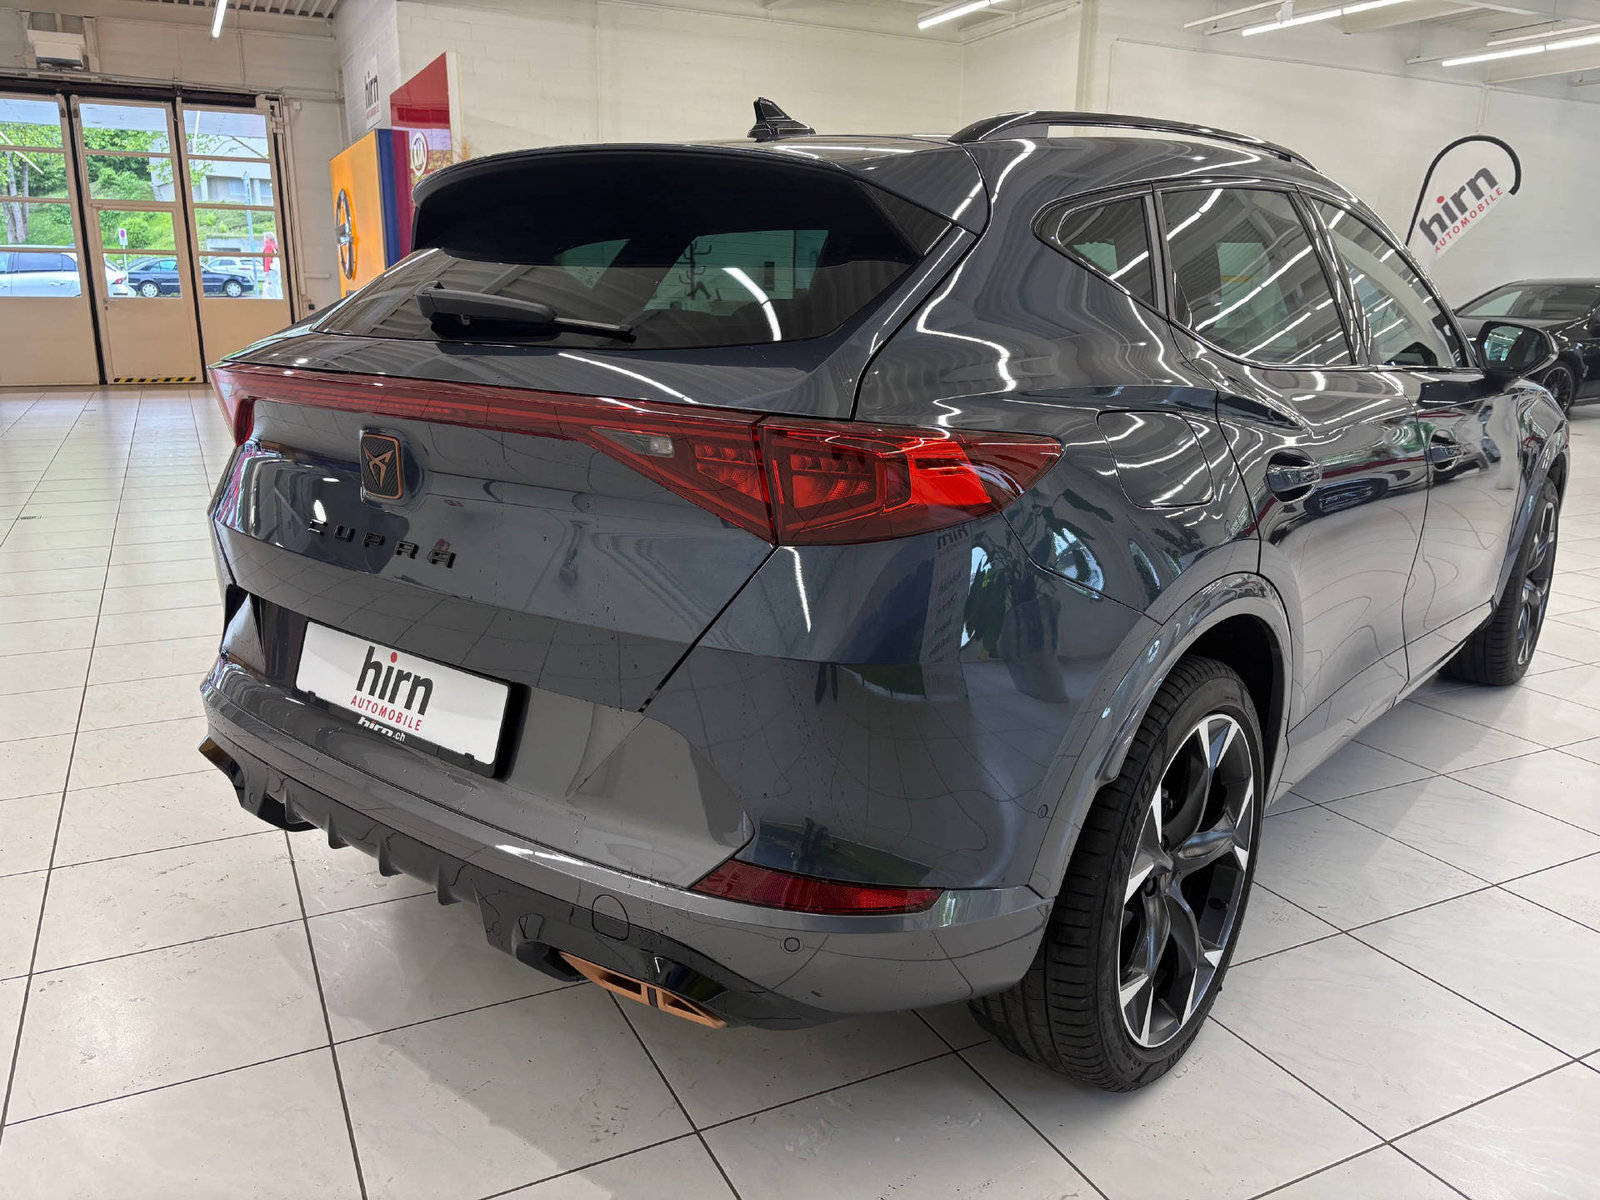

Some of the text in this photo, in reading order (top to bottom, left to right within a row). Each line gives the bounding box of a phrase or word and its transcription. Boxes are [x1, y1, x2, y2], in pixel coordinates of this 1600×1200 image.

[1419, 167, 1498, 246] hirn
[1434, 187, 1503, 253] AUTOMOBILE
[307, 518, 456, 569] CUPRA
[355, 645, 434, 716] hirn
[350, 694, 423, 731] AUTOMOBILE
[358, 716, 406, 742] hirn.ch
